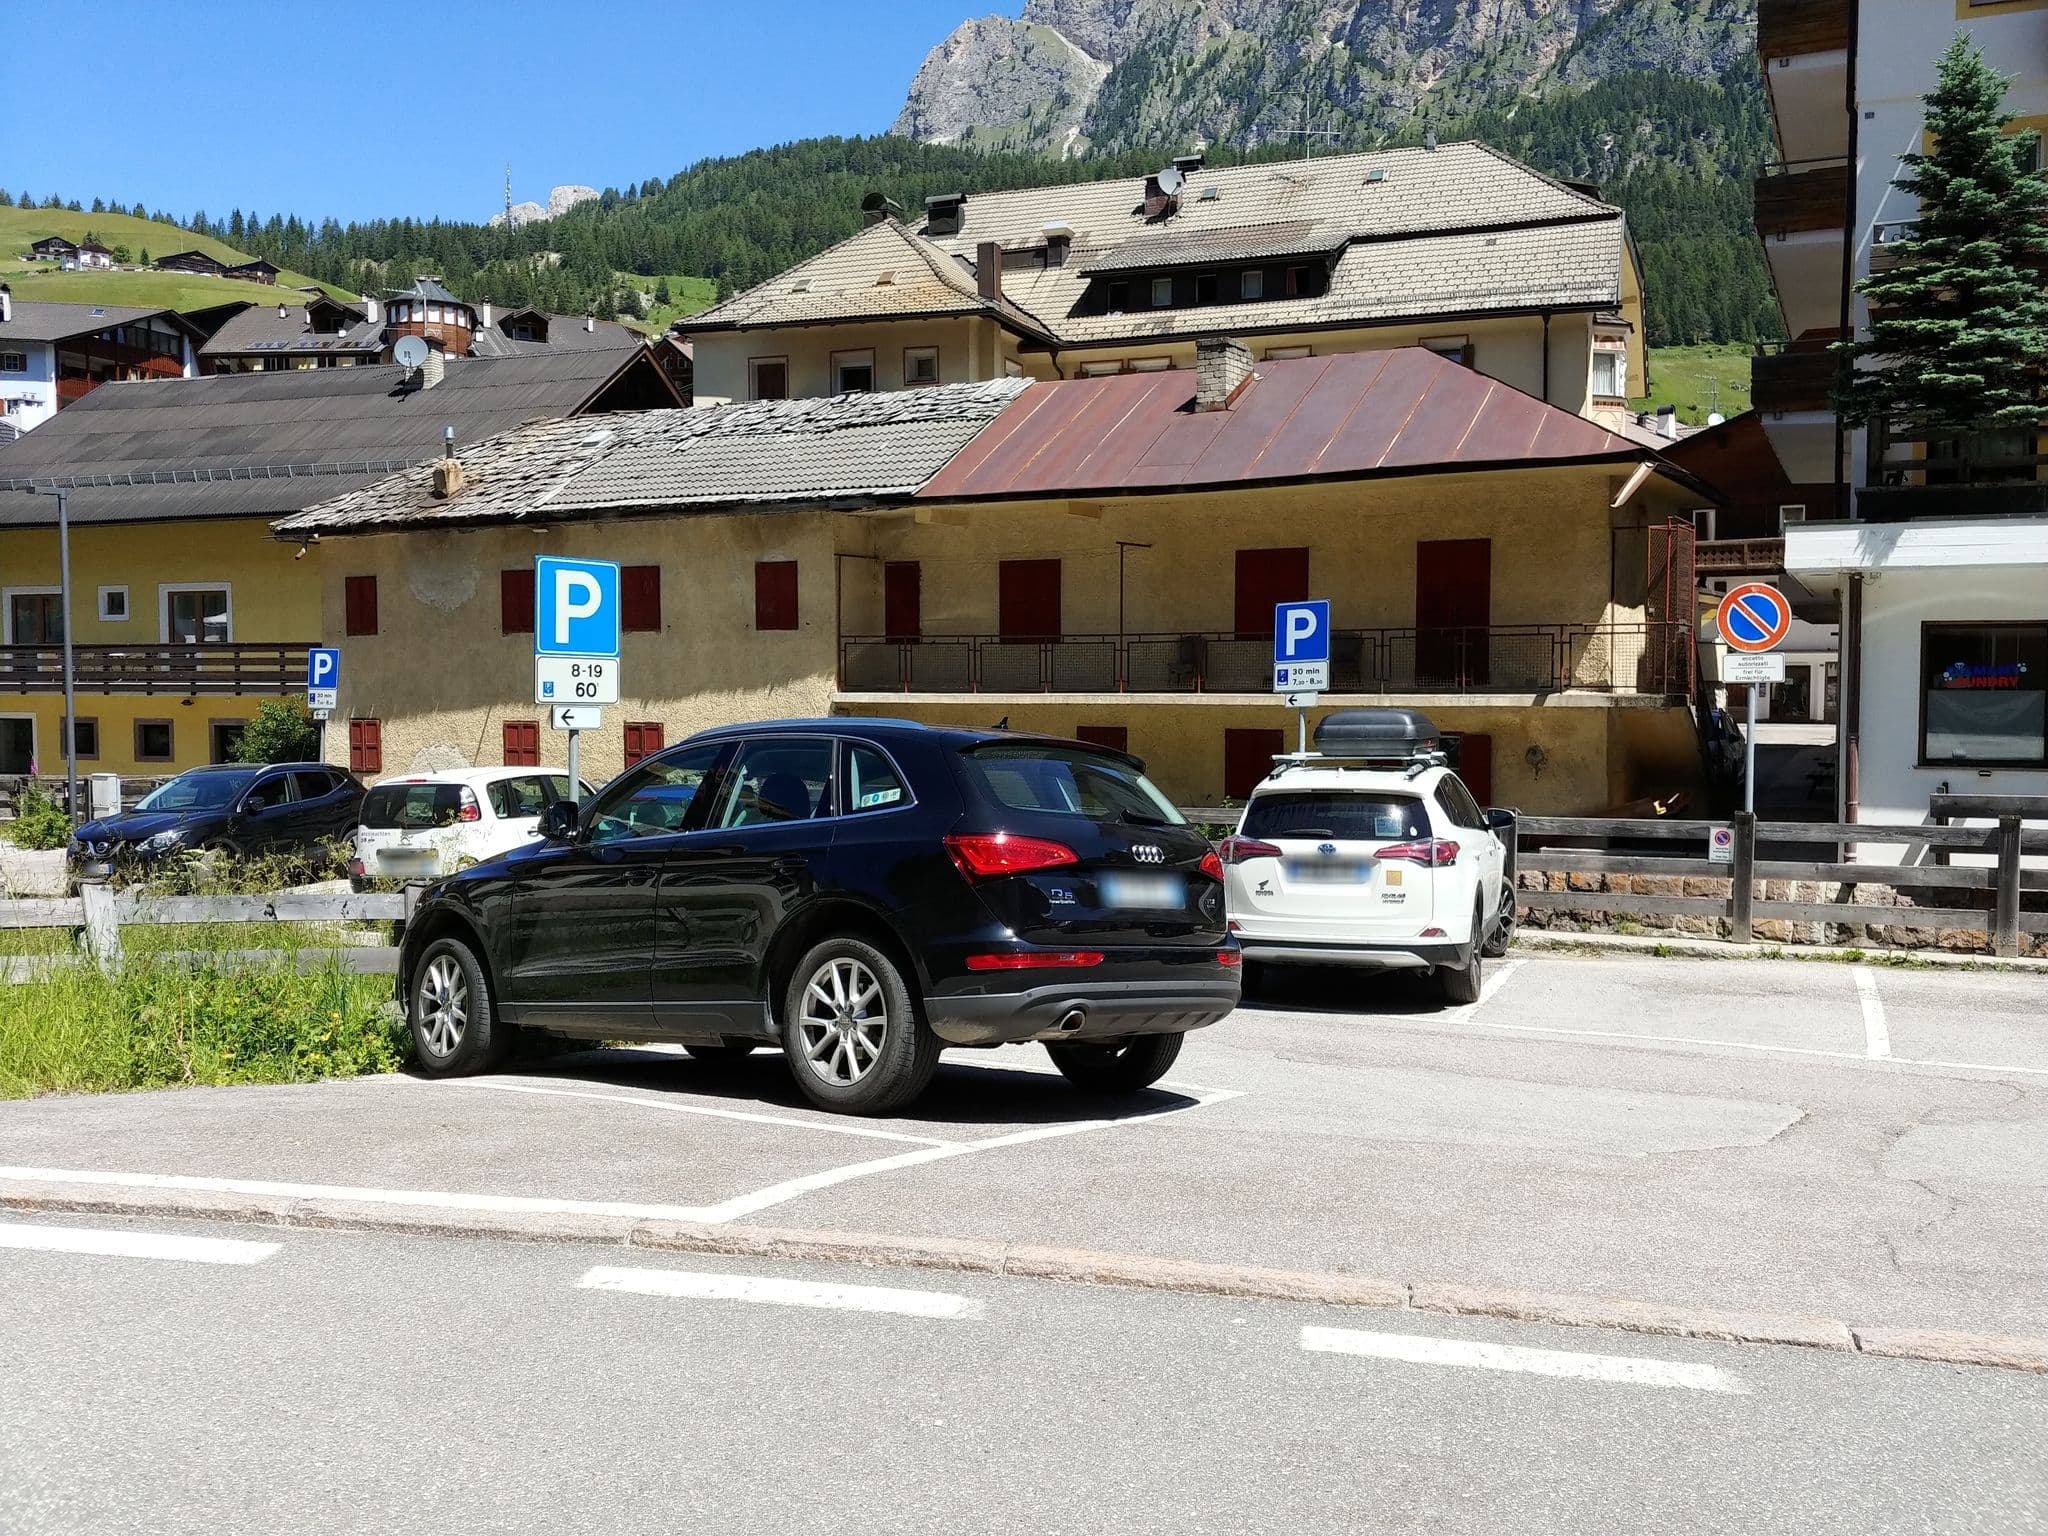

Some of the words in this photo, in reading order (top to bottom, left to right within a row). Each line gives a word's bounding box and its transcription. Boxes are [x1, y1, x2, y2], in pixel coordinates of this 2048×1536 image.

[555, 569, 602, 644] P
[1286, 608, 1317, 656] P
[314, 653, 333, 685] P
[571, 664, 603, 678] 8-19
